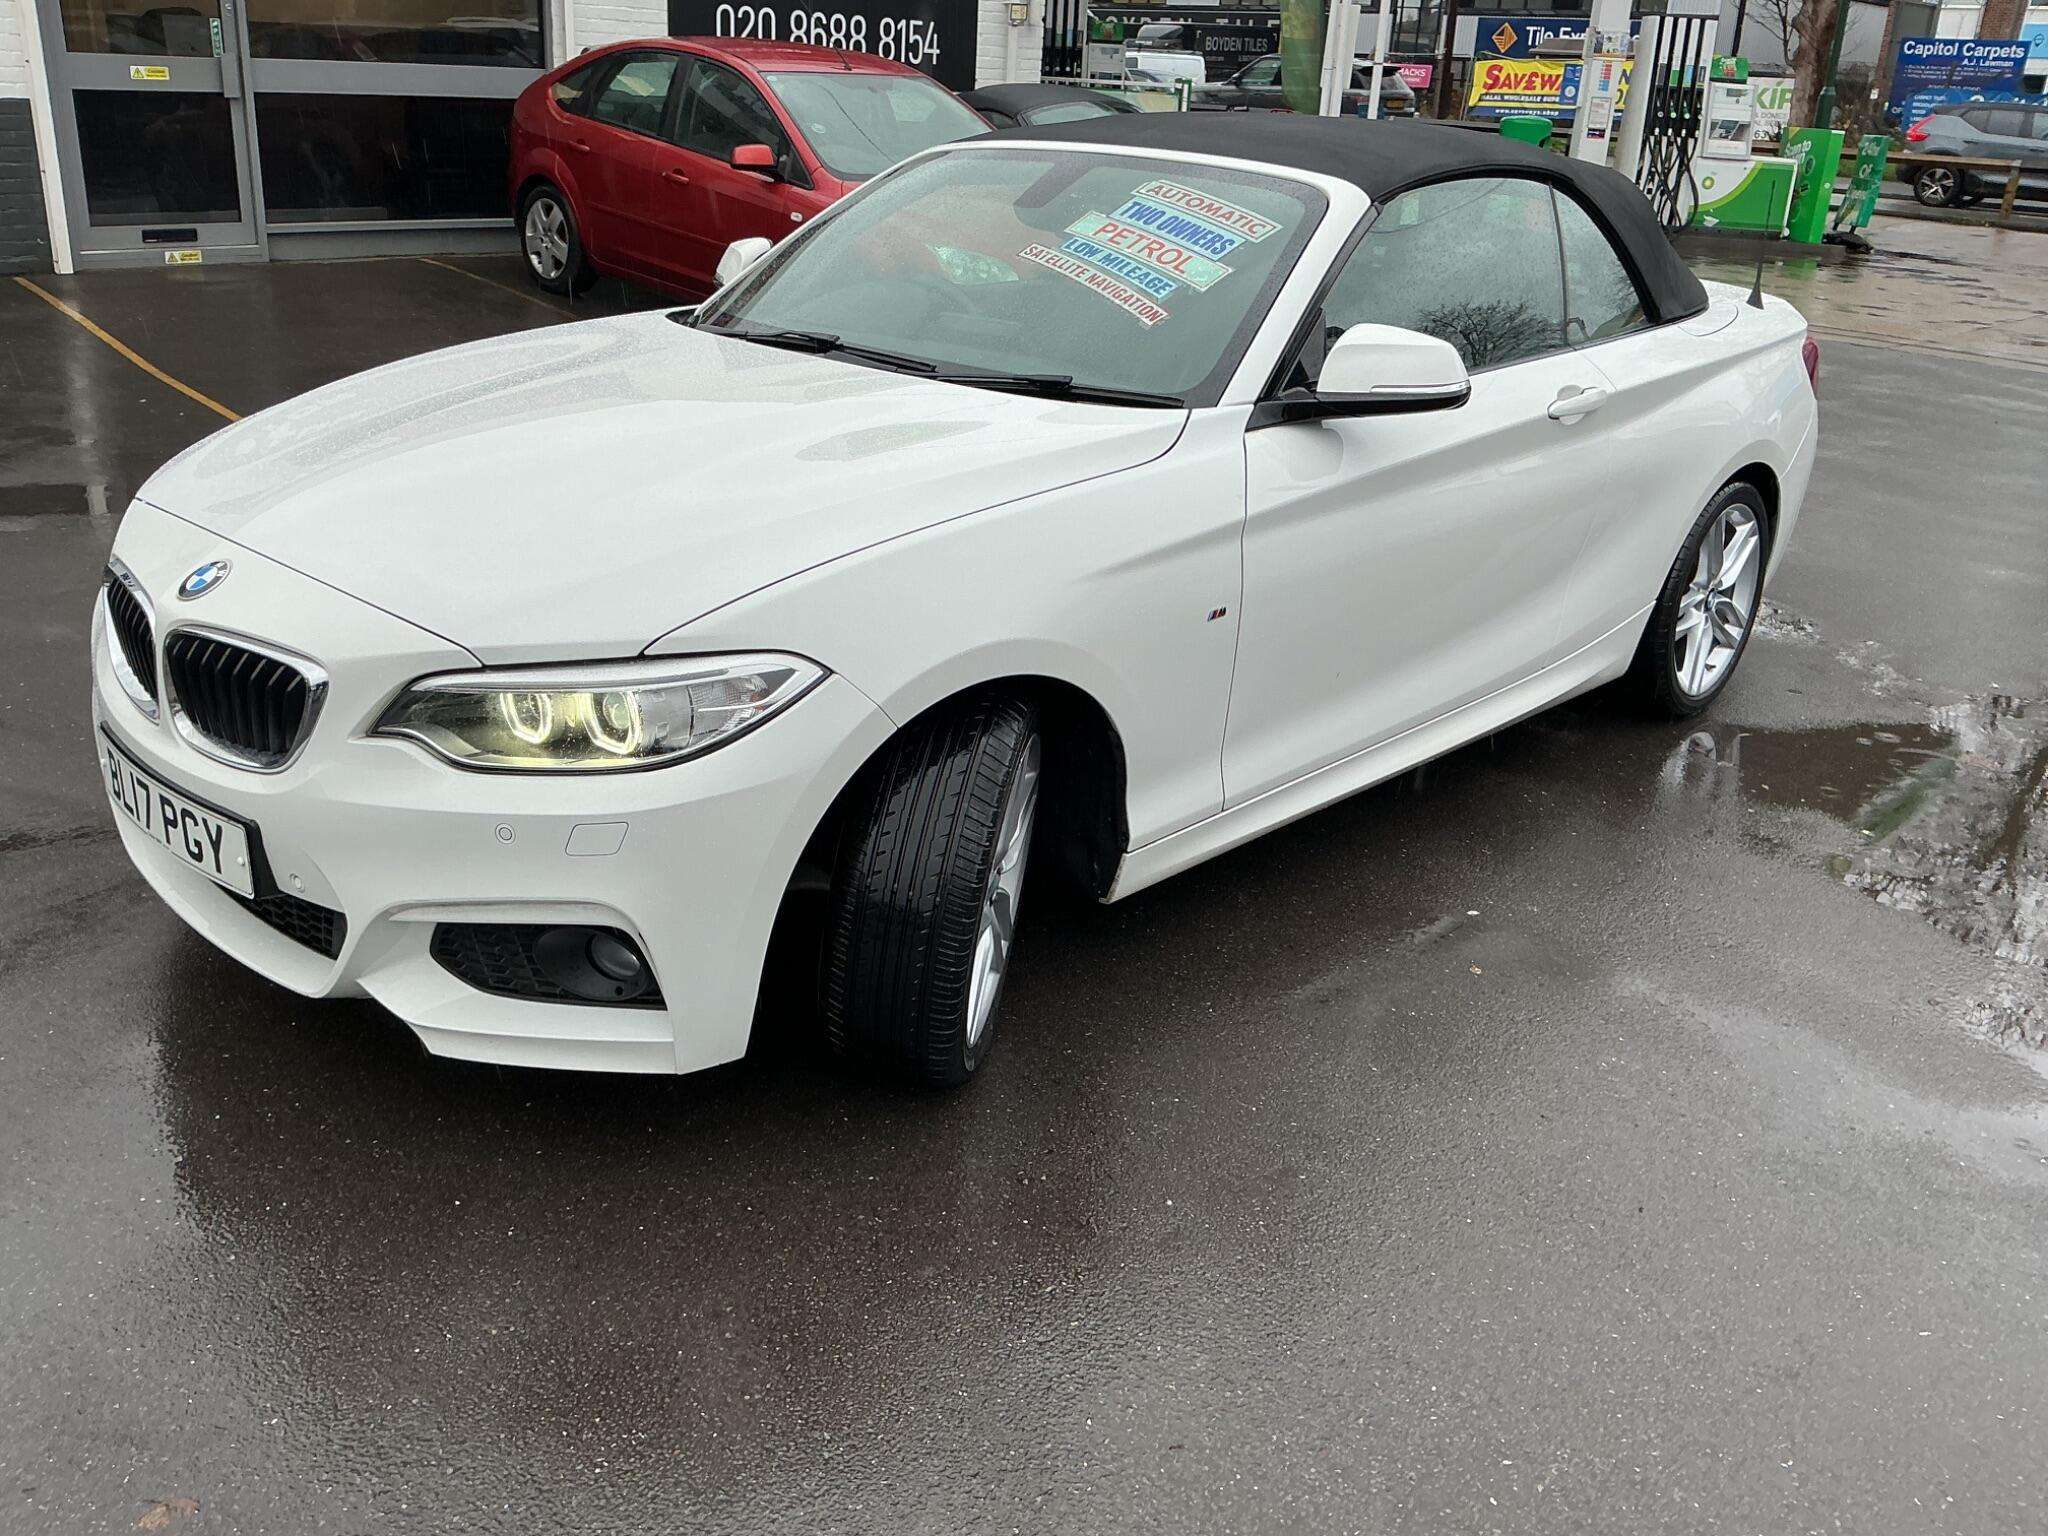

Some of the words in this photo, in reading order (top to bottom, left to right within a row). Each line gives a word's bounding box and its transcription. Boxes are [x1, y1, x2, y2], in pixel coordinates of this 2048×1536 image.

[715, 4, 776, 41] 020
[790, 10, 867, 53] 8688
[879, 17, 940, 65] 8154
[1205, 36, 1242, 51] BOYDEN
[1244, 38, 1268, 51] TILES
[1903, 41, 1958, 58] Capitol
[1962, 42, 2026, 59] Carpets
[1962, 58, 1978, 66] A.J.
[1980, 59, 2014, 67] Lawman
[1119, 200, 1166, 226] TWO
[1155, 215, 1236, 255] OWNERS
[1146, 184, 1266, 235] AUTOMATIC
[1064, 238, 1103, 259] LOW
[1101, 252, 1174, 295] MILEAGE
[1092, 222, 1194, 274] PETROL
[1024, 245, 1090, 279] SATELLITE
[1084, 273, 1164, 323] NAVIGATION
[107, 746, 150, 830] BL17
[158, 792, 222, 875] PGY
